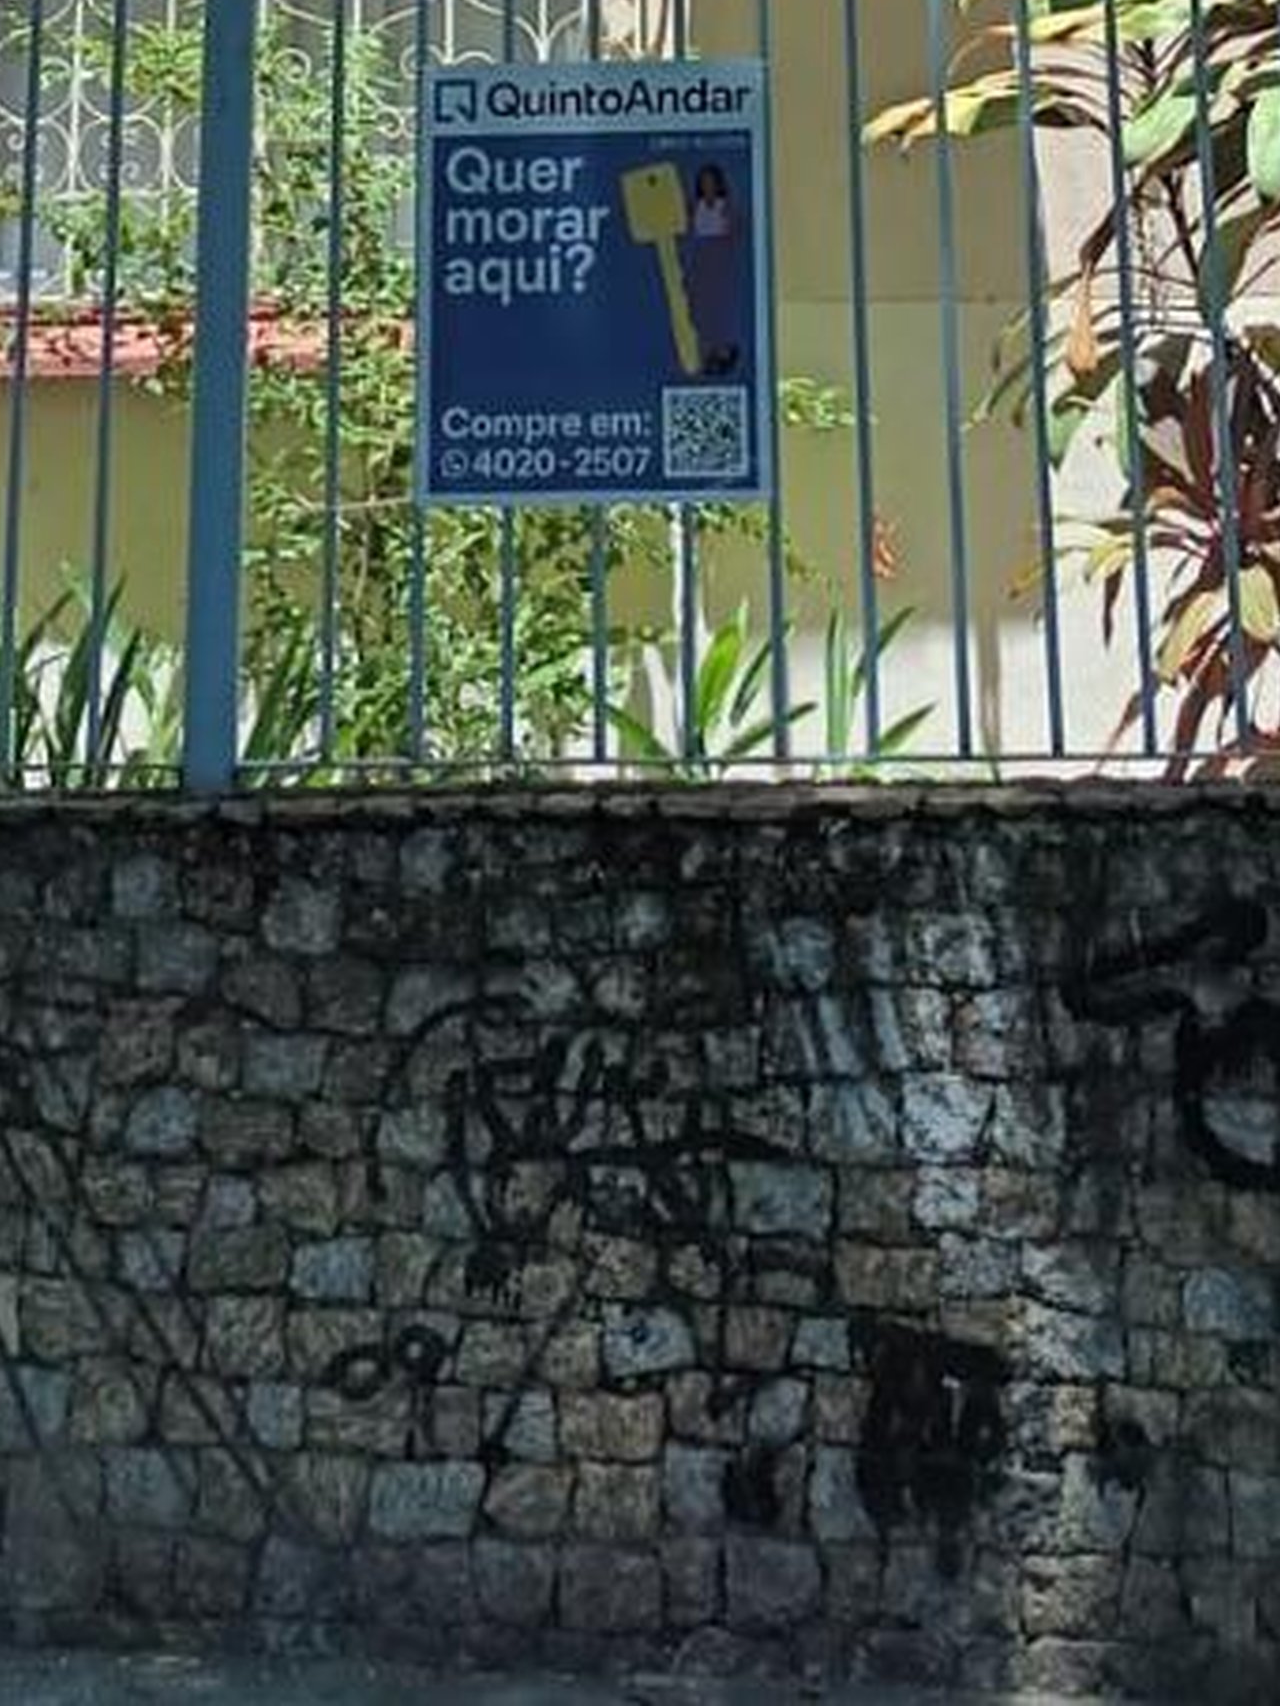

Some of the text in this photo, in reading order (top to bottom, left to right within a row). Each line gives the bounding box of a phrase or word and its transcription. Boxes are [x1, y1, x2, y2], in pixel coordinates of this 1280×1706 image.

[488, 79, 750, 118] QuintoAndar
[447, 148, 583, 193] Quer
[447, 205, 609, 243] morar
[446, 245, 594, 305] aqui?
[441, 408, 652, 444] Compre em:
[475, 450, 651, 476] 4020-2507
